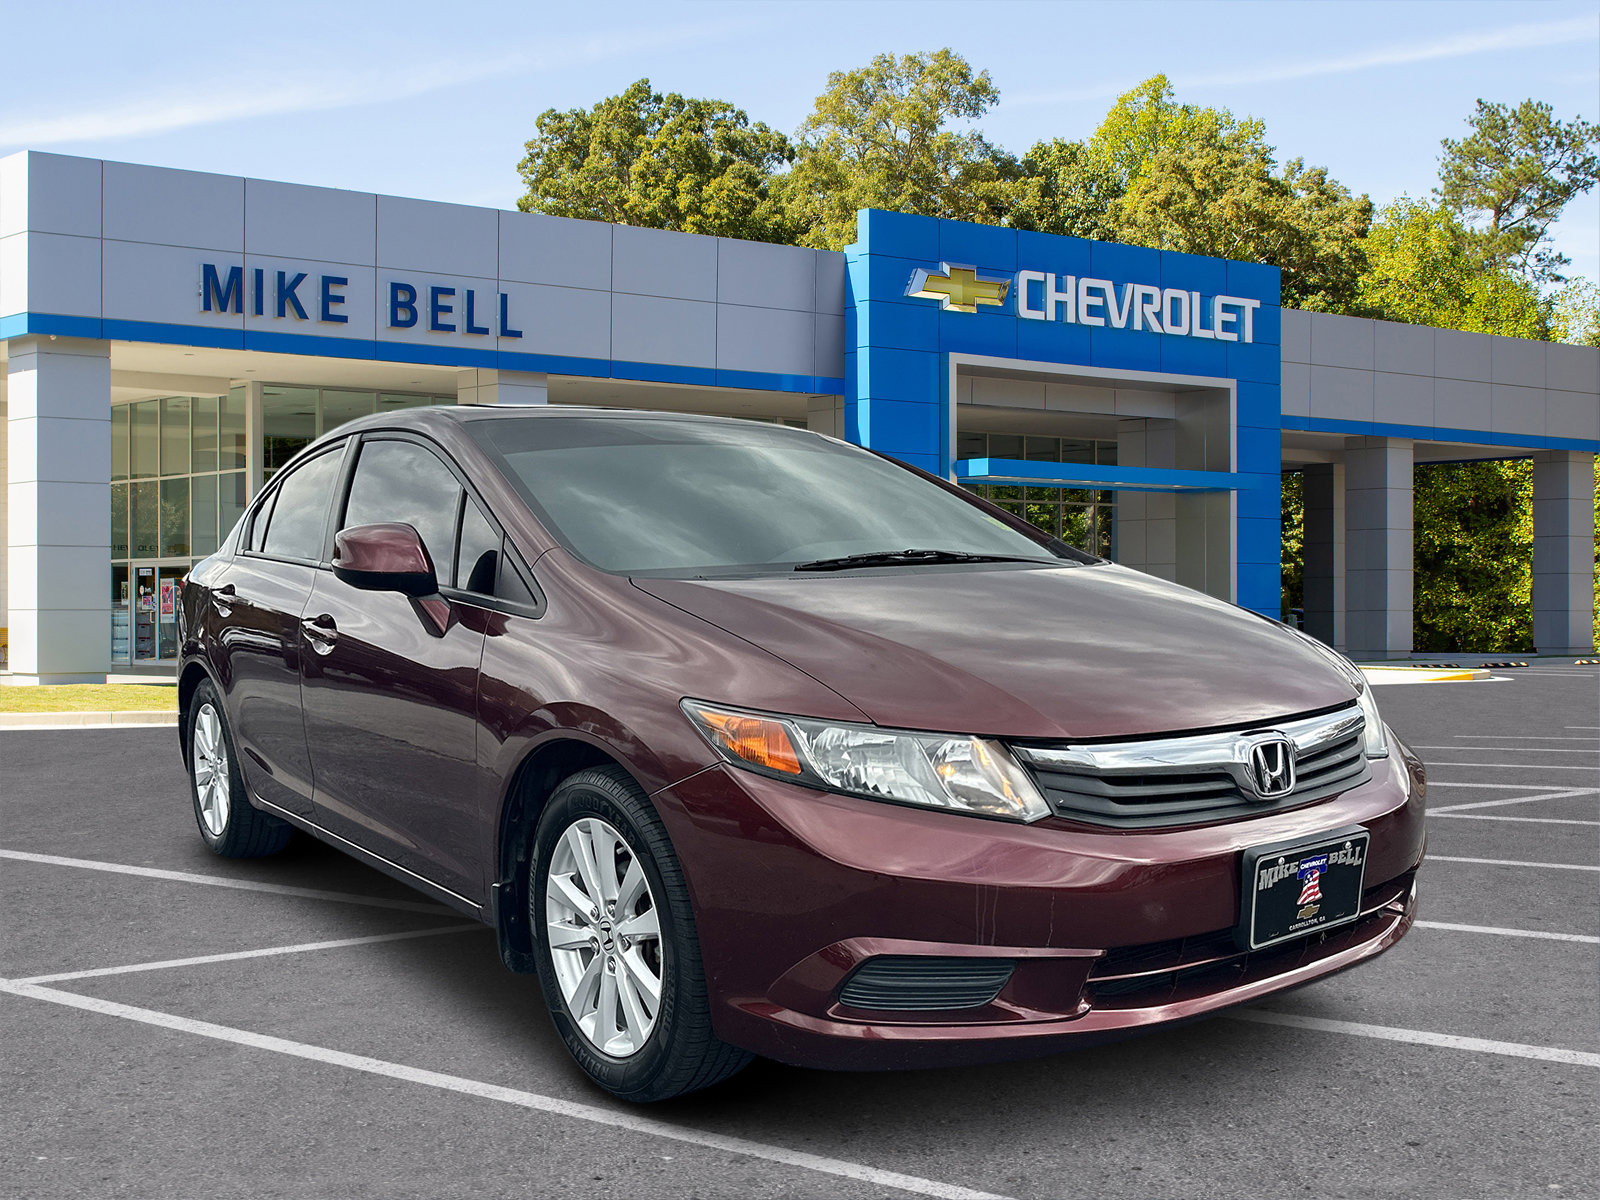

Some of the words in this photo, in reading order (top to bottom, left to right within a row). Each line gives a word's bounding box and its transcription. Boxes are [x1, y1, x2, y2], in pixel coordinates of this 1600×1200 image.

[199, 263, 349, 324] MIKE
[387, 281, 524, 339] BELL
[1014, 269, 1261, 344] CHEVROLET
[1258, 861, 1299, 891] MIKE
[1328, 846, 1362, 867] BELL
[1299, 857, 1328, 870] CHEVROLET
